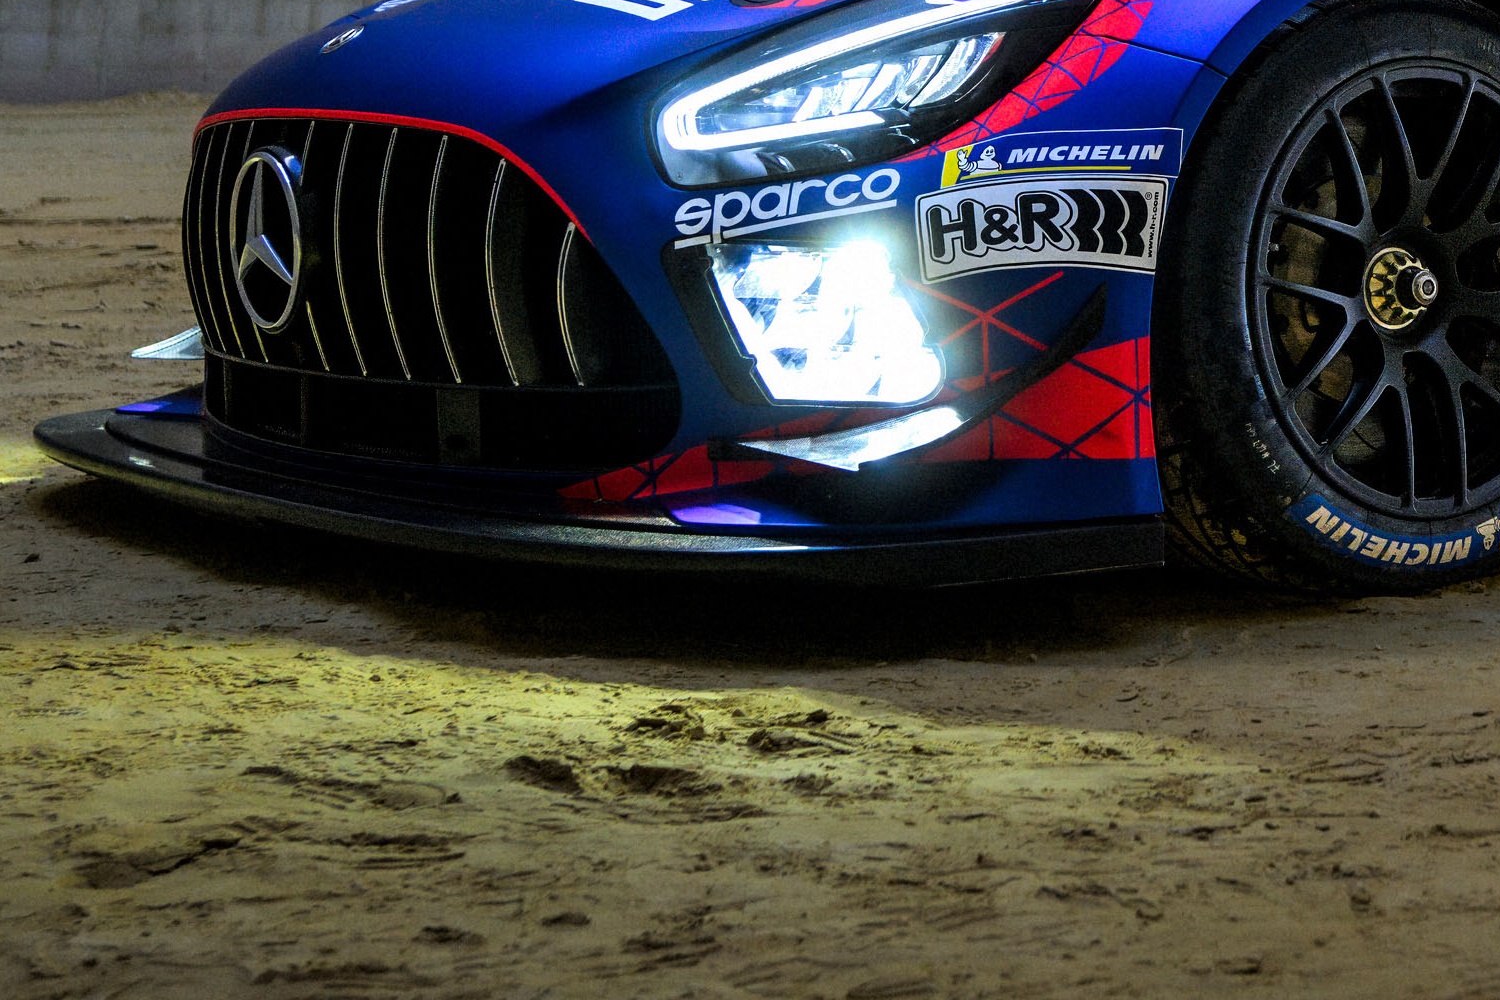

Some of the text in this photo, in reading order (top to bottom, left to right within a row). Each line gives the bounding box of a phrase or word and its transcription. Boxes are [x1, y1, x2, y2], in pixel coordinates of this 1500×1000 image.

[1006, 144, 1165, 164] MICHELIN
[674, 168, 901, 246] sparco
[927, 193, 1068, 260] H&R
[1147, 191, 1160, 259] www.h-r.com
[1304, 505, 1472, 567] MICHELIN
